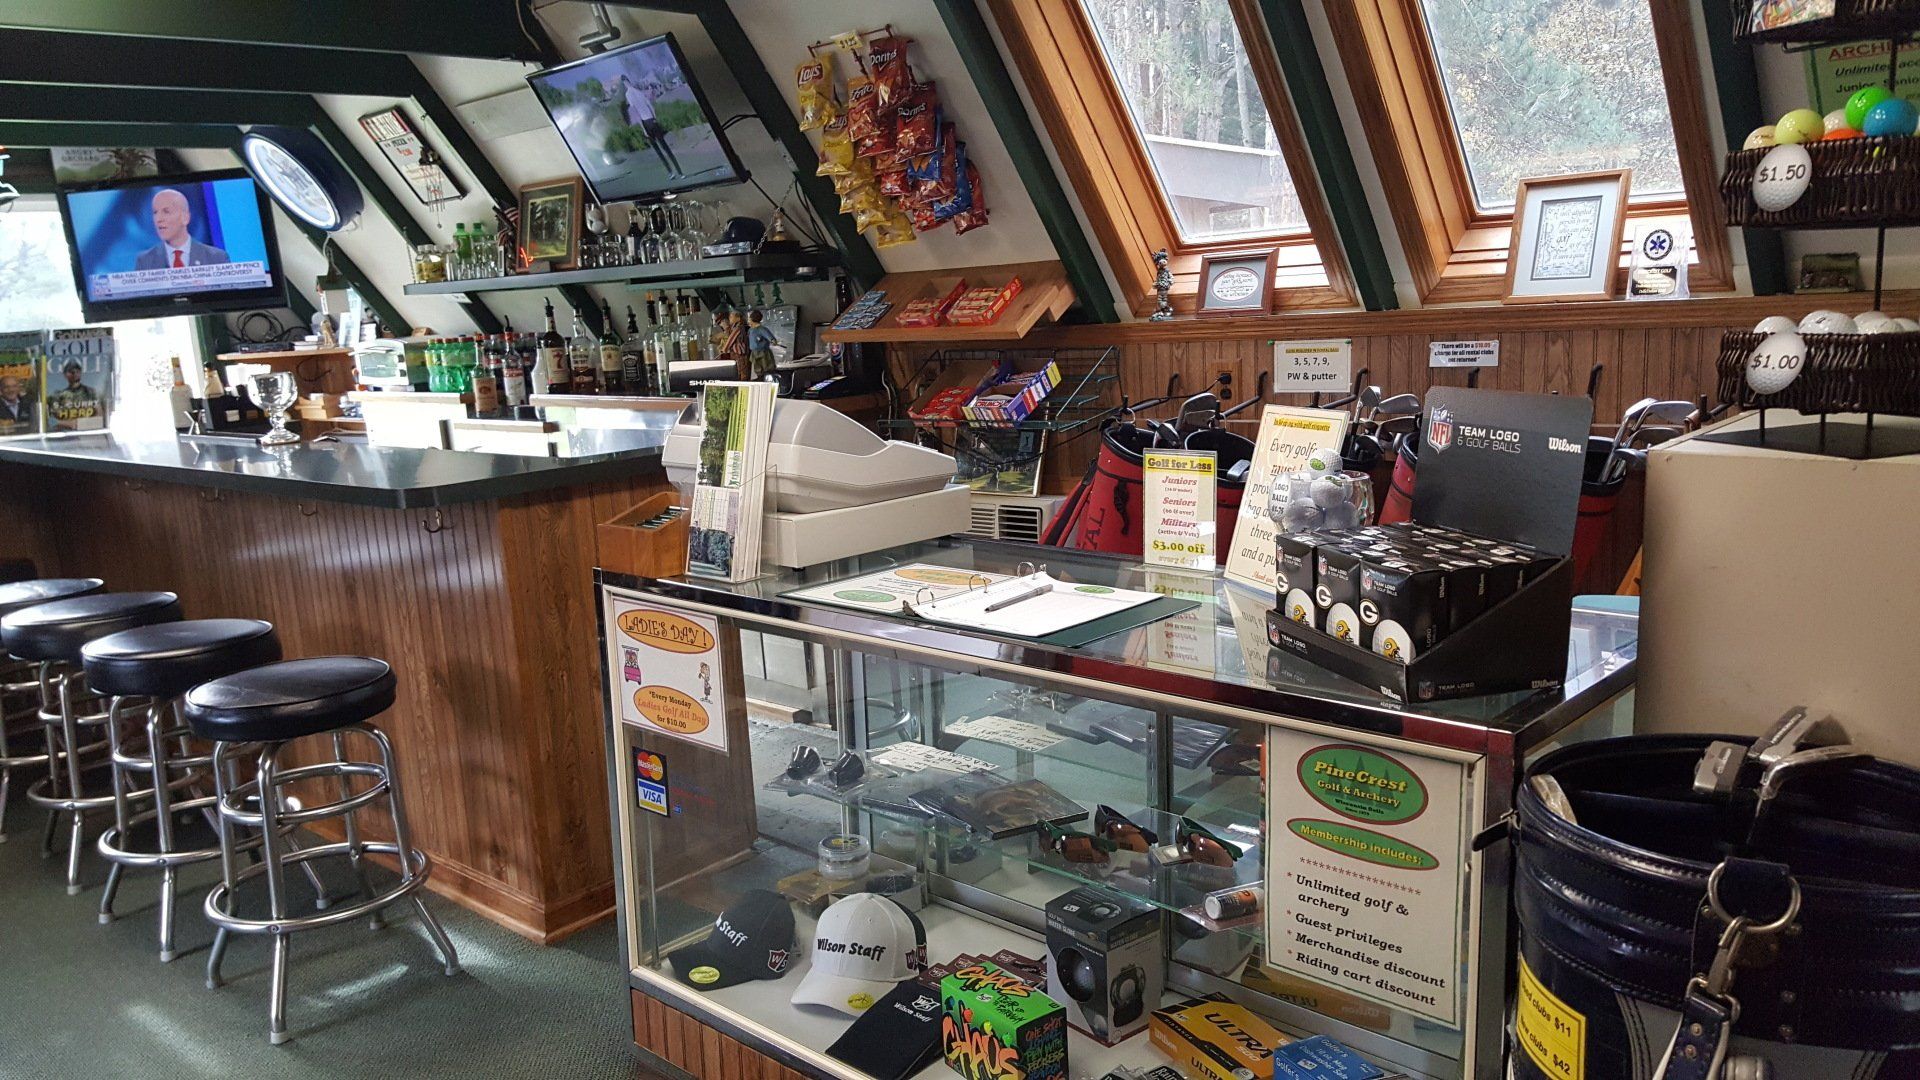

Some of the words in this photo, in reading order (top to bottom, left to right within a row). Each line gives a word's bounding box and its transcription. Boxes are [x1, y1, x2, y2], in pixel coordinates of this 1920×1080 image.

[1758, 164, 1807, 184] $1.50
[1294, 357, 1301, 366] 3,
[1303, 357, 1311, 366] 5,
[1313, 357, 1320, 366] 7,
[1322, 356, 1330, 366] 9,
[1751, 354, 1799, 369] $1.00
[1287, 372, 1300, 380] PW
[1303, 372, 1309, 380] &
[1312, 372, 1337, 381] putter
[1431, 421, 1452, 446] NFL
[1459, 425, 1486, 438] TEAM
[1490, 429, 1520, 442] LOGO
[1270, 438, 1294, 458] Every
[1457, 436, 1463, 446] 6
[1466, 437, 1490, 449] GOLF
[1492, 441, 1521, 454] BALLS
[1548, 436, 1582, 454] Wilson
[1147, 457, 1169, 467] Golf
[1171, 459, 1187, 469] for
[1190, 460, 1212, 470] Less
[1162, 475, 1198, 486] Juniors
[1162, 497, 1197, 507] Seniors
[1161, 517, 1198, 530] Military
[1250, 524, 1273, 542] three
[1153, 540, 1185, 551] $3.00
[1187, 543, 1206, 554] off
[1241, 547, 1259, 560] and
[1258, 552, 1264, 562] a
[1360, 601, 1379, 625] G
[625, 615, 668, 638] LADIE'S
[670, 623, 699, 645] DAY
[669, 695, 692, 709] Monday
[1380, 685, 1402, 702] Wilson
[662, 704, 678, 717] Golf
[679, 707, 690, 719] All
[656, 714, 665, 723] for
[666, 716, 687, 729] $10.00
[1313, 760, 1408, 793] PineCrest
[642, 788, 662, 805] VISA
[1317, 779, 1340, 793] Golf
[1353, 788, 1401, 808] Archery
[1300, 825, 1367, 851] Membership
[1296, 874, 1361, 903] Unlimited
[1364, 897, 1394, 913] golf
[1396, 903, 1410, 916] &
[1298, 893, 1350, 917] archery
[720, 920, 748, 947] Staff
[1295, 912, 1333, 932] Guest
[1335, 925, 1403, 954] privileges
[816, 938, 846, 955] Wilson
[848, 942, 887, 962] Staff
[1295, 932, 1380, 967] Merchandise
[1384, 961, 1446, 989] discount
[1296, 952, 1339, 976] Riding
[1343, 969, 1372, 985] cart
[1375, 979, 1437, 1006] discount
[1532, 999, 1552, 1023] clubs
[1554, 1016, 1572, 1038] $11
[1204, 1012, 1274, 1059] ULTRA
[943, 1013, 1026, 1080] CHAOS
[1321, 1039, 1349, 1058] Golfer's
[1529, 1032, 1548, 1057] clubs
[1552, 1053, 1571, 1076] $42
